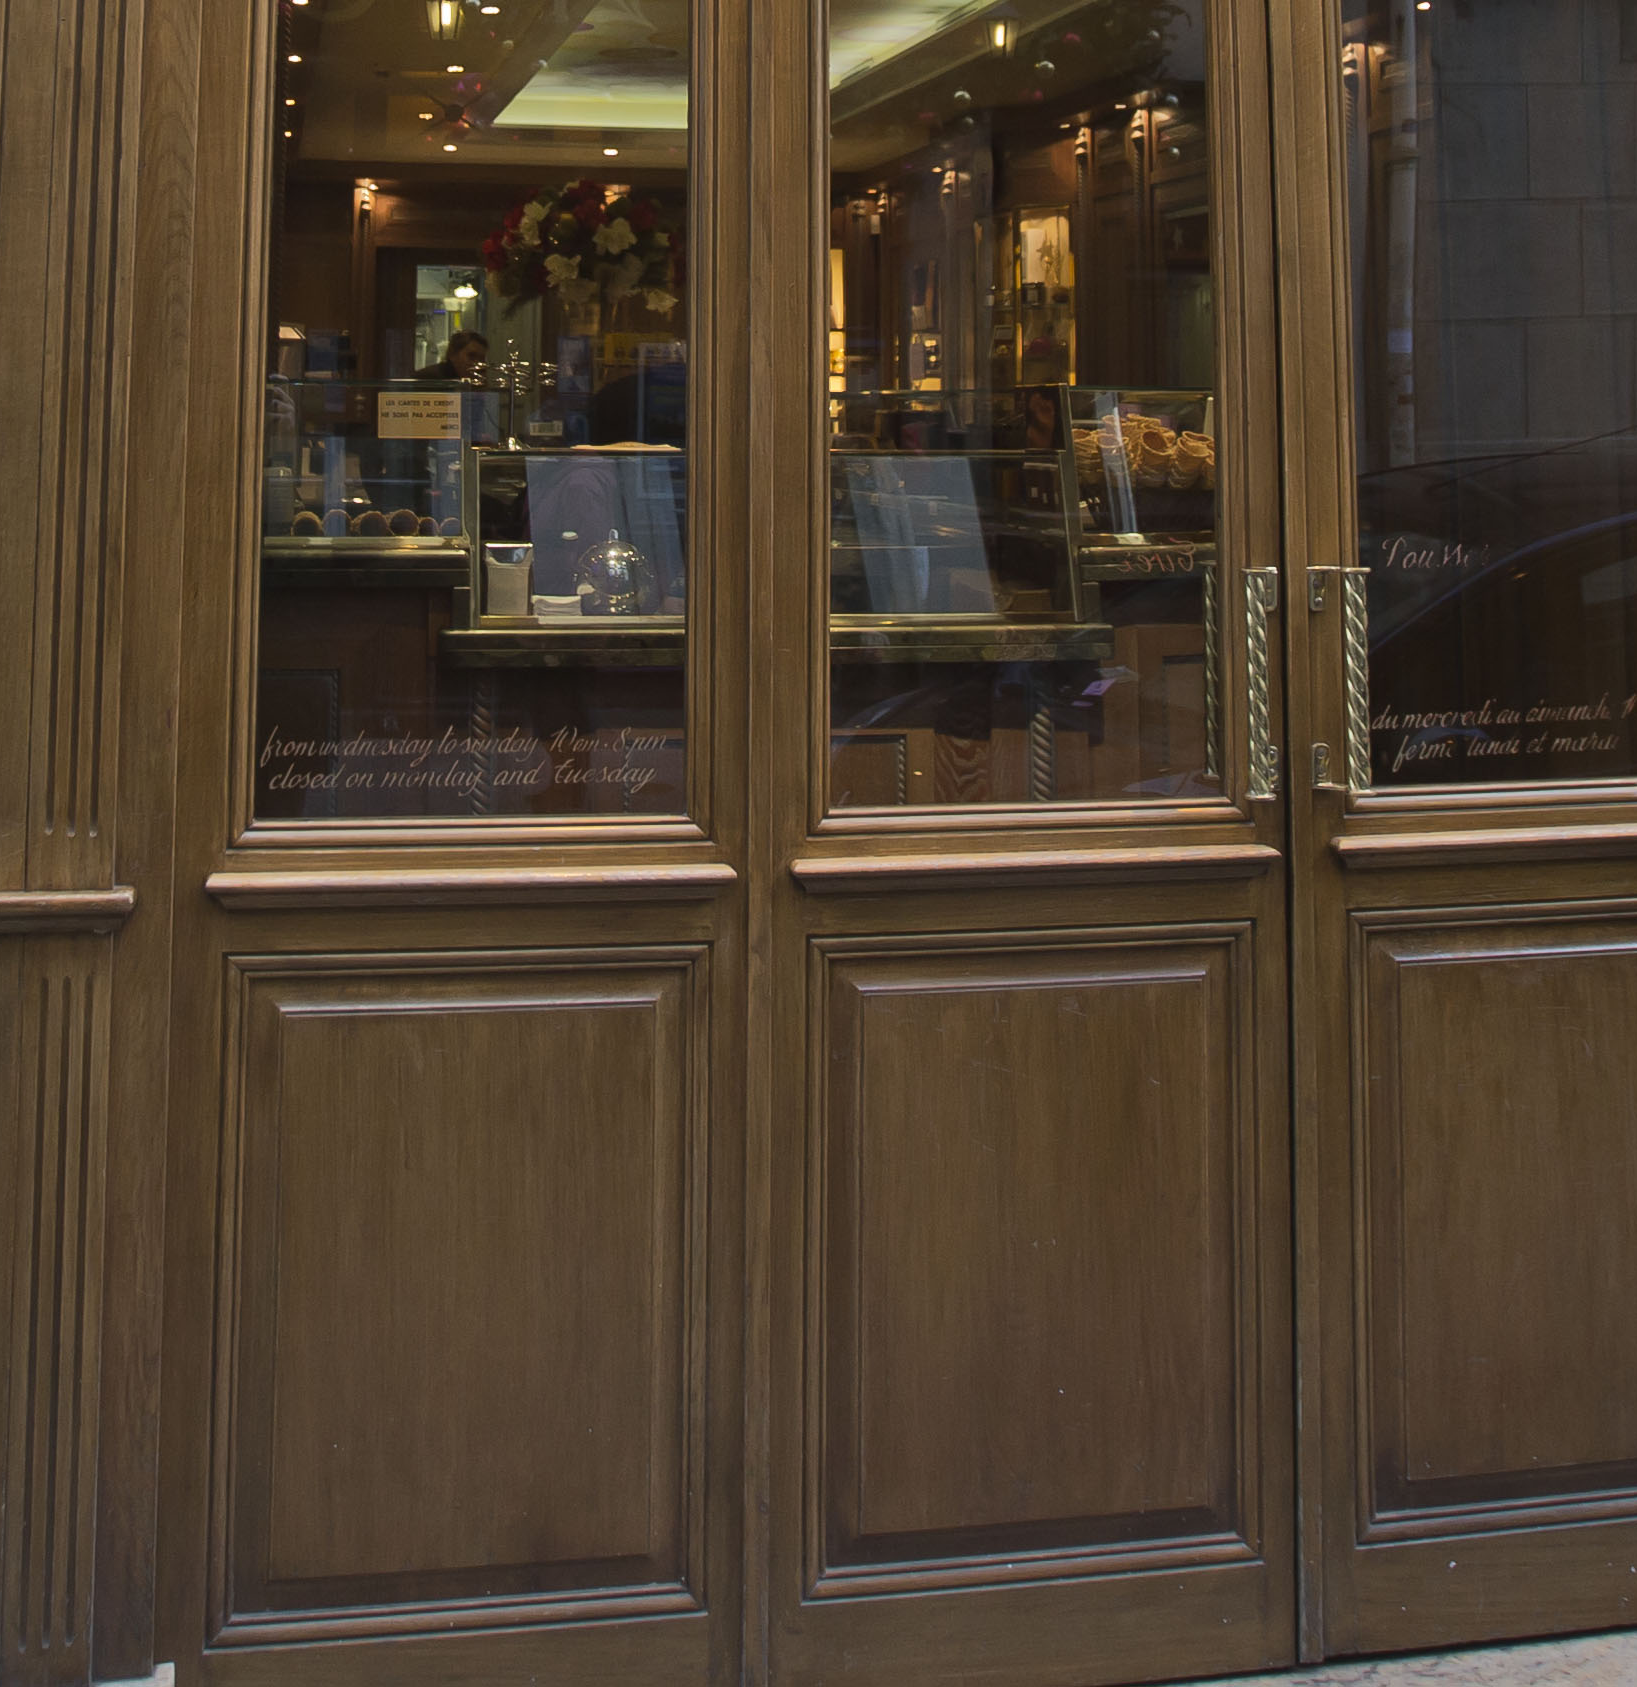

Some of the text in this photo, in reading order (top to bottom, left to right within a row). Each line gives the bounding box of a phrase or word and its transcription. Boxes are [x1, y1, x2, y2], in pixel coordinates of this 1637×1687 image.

[1371, 704, 1399, 729] du
[1496, 709, 1521, 724] au
[260, 725, 317, 768] from
[436, 725, 457, 754] to
[269, 759, 657, 796] closed on monday and tuesday
